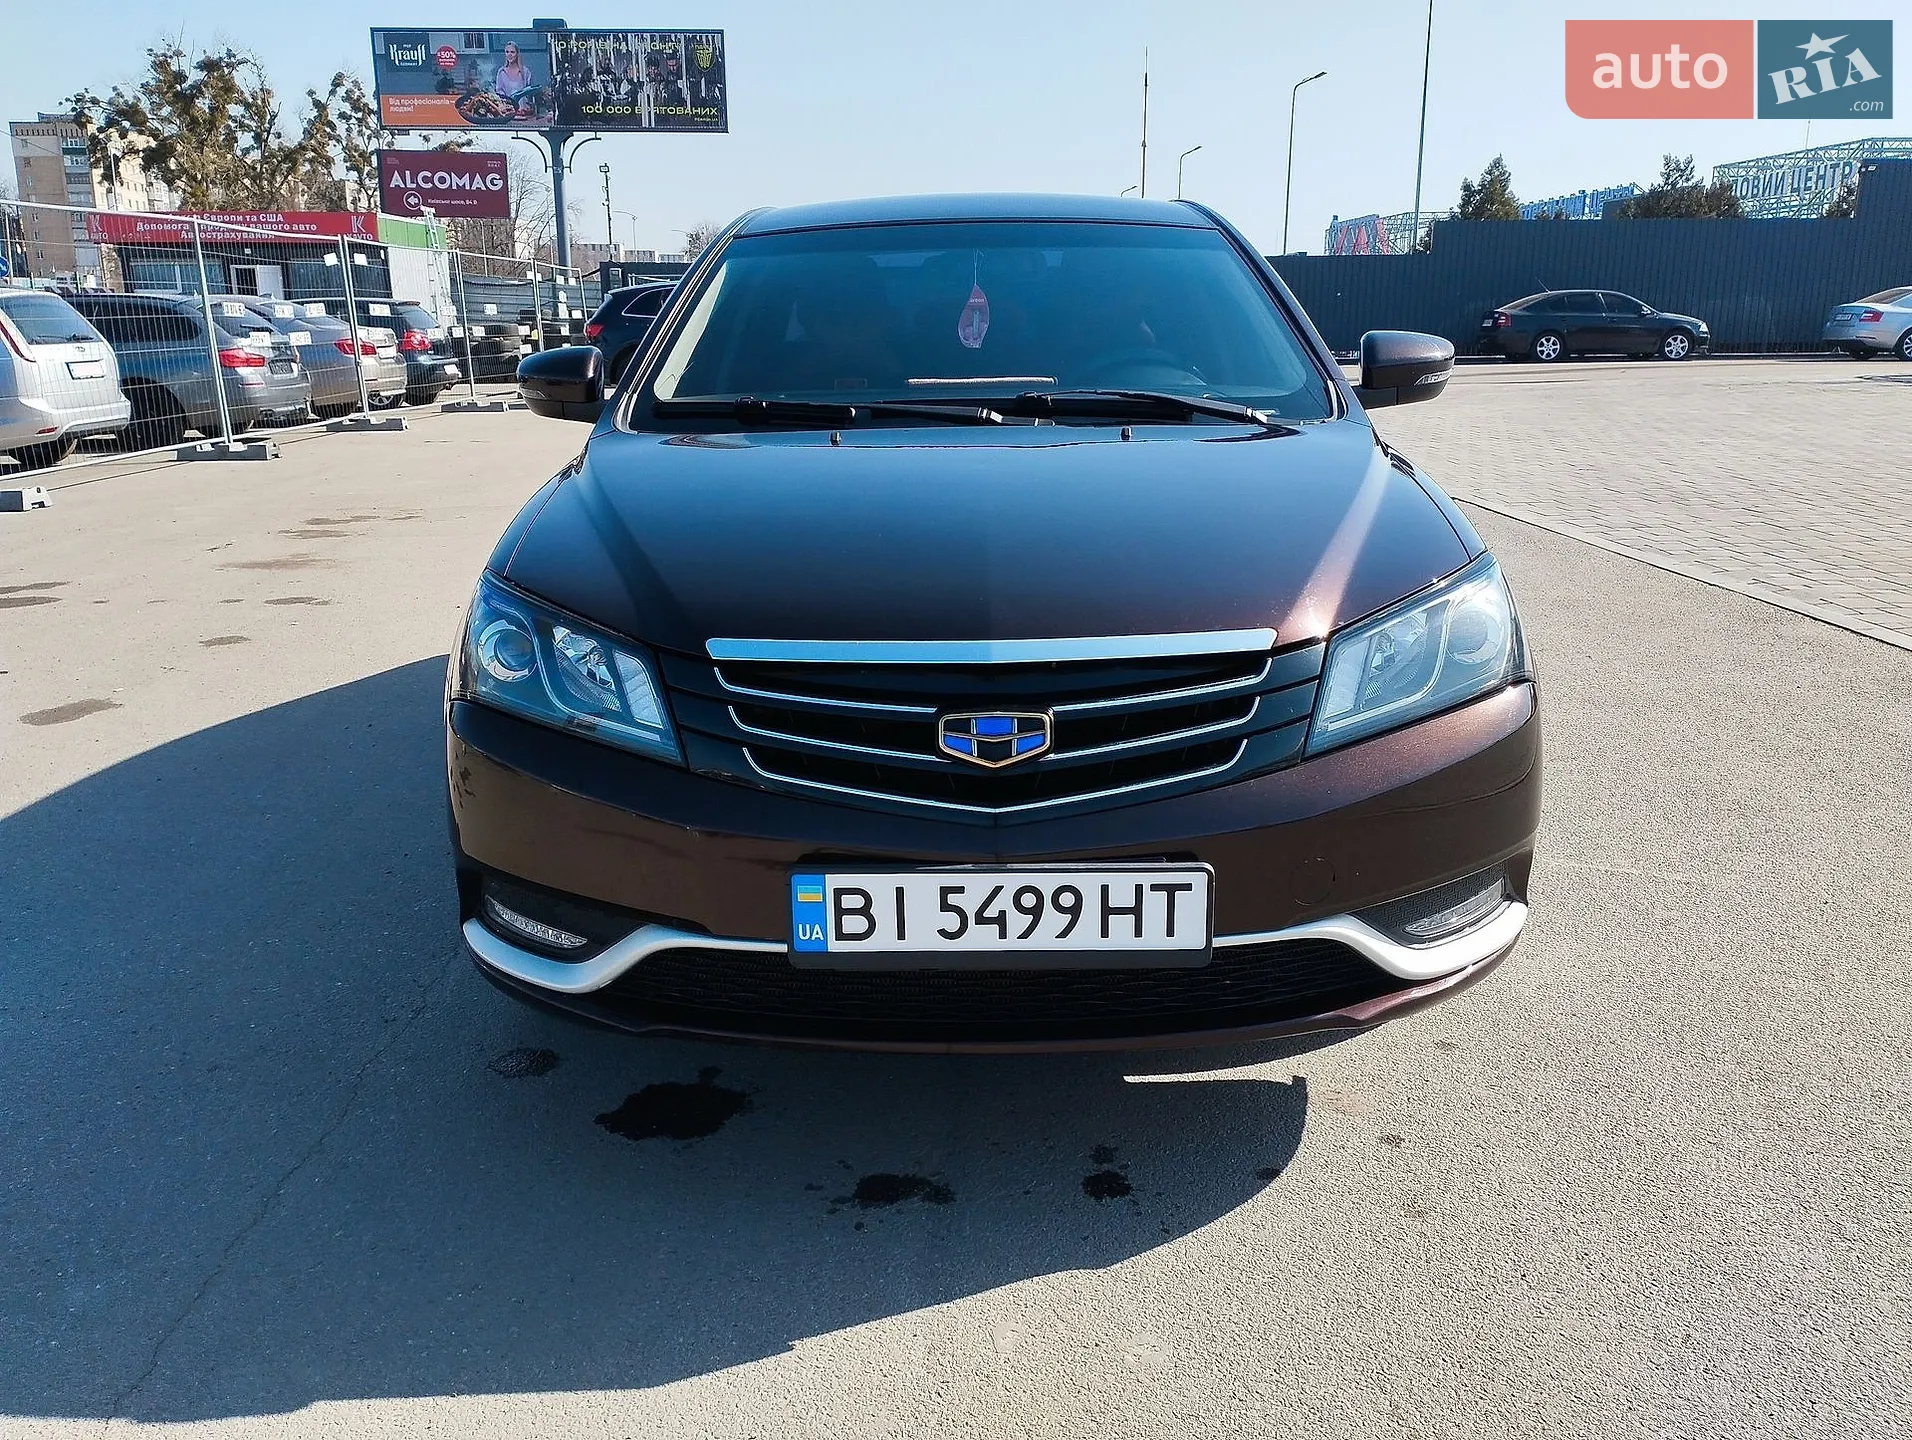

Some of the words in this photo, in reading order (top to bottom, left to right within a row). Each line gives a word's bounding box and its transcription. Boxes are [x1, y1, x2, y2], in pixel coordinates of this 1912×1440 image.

[581, 105, 602, 114] 100
[606, 105, 632, 114] 000
[389, 170, 504, 191] ALCOMAG
[1791, 161, 1855, 201] ЦЕНТР
[203, 213, 243, 223] Європи
[259, 213, 284, 222] США
[136, 222, 190, 232] Допомога
[180, 230, 275, 241] Авострахування
[832, 886, 907, 942] BI
[936, 883, 1085, 941] 5499
[1099, 881, 1194, 940] HT
[797, 923, 825, 941] UA
